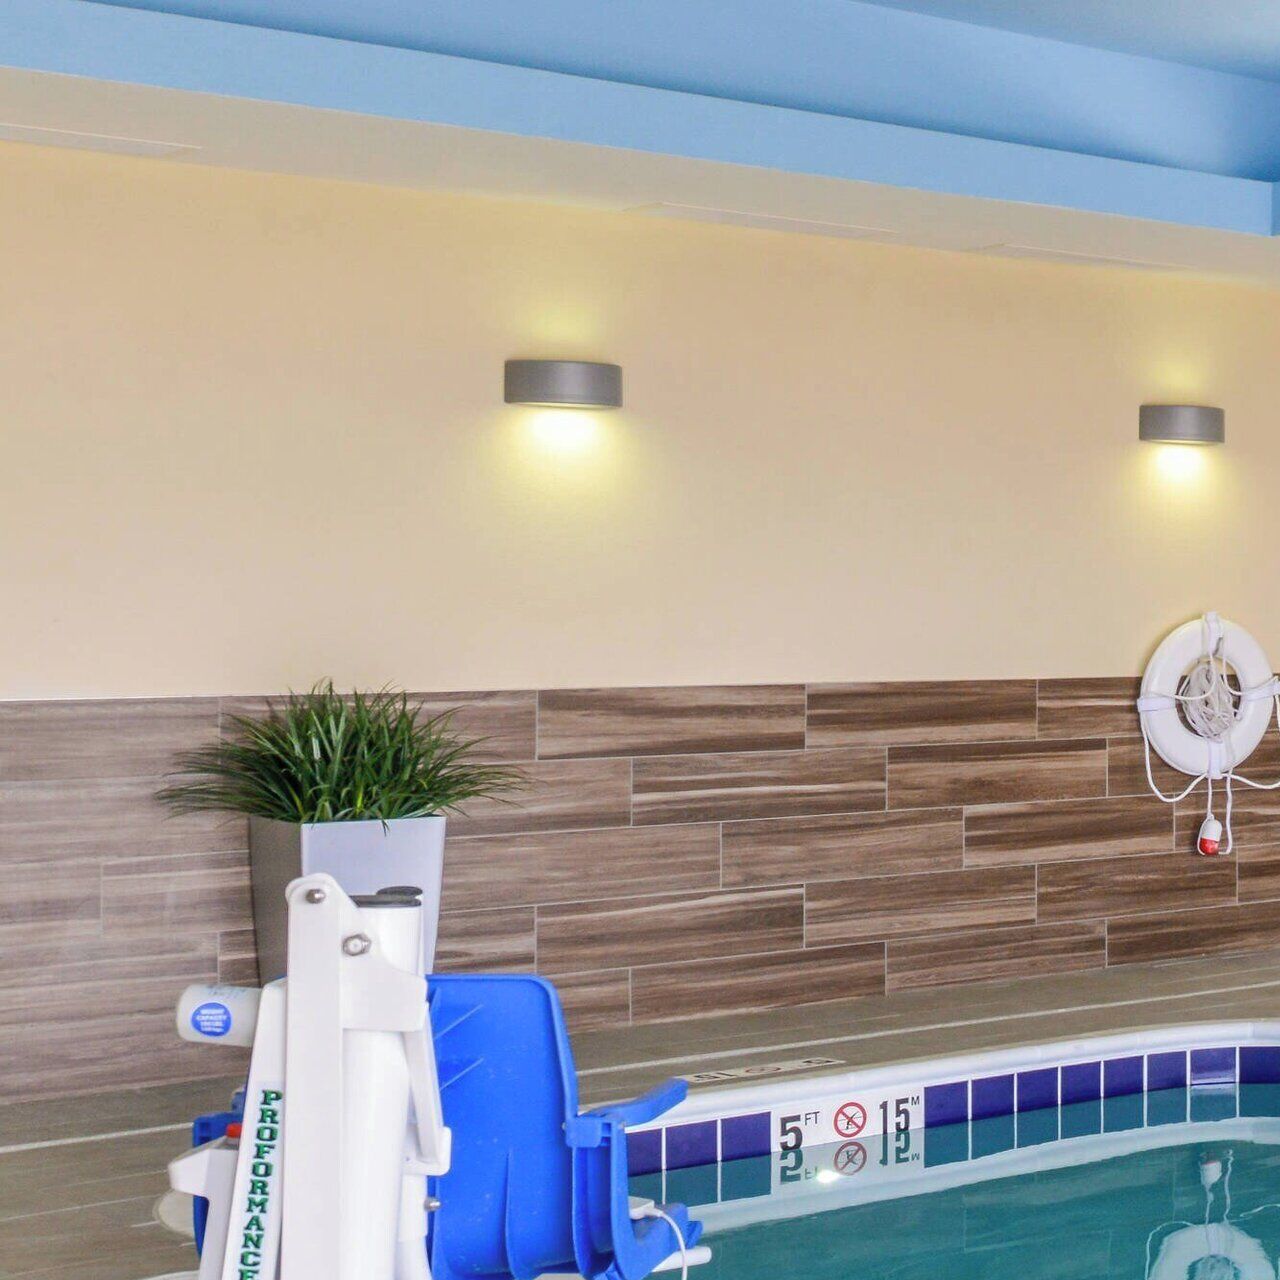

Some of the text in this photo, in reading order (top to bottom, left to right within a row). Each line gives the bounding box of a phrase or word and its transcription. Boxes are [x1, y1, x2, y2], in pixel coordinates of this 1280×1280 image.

[911, 1095, 920, 1106] M
[779, 1111, 820, 1151] 5 FT
